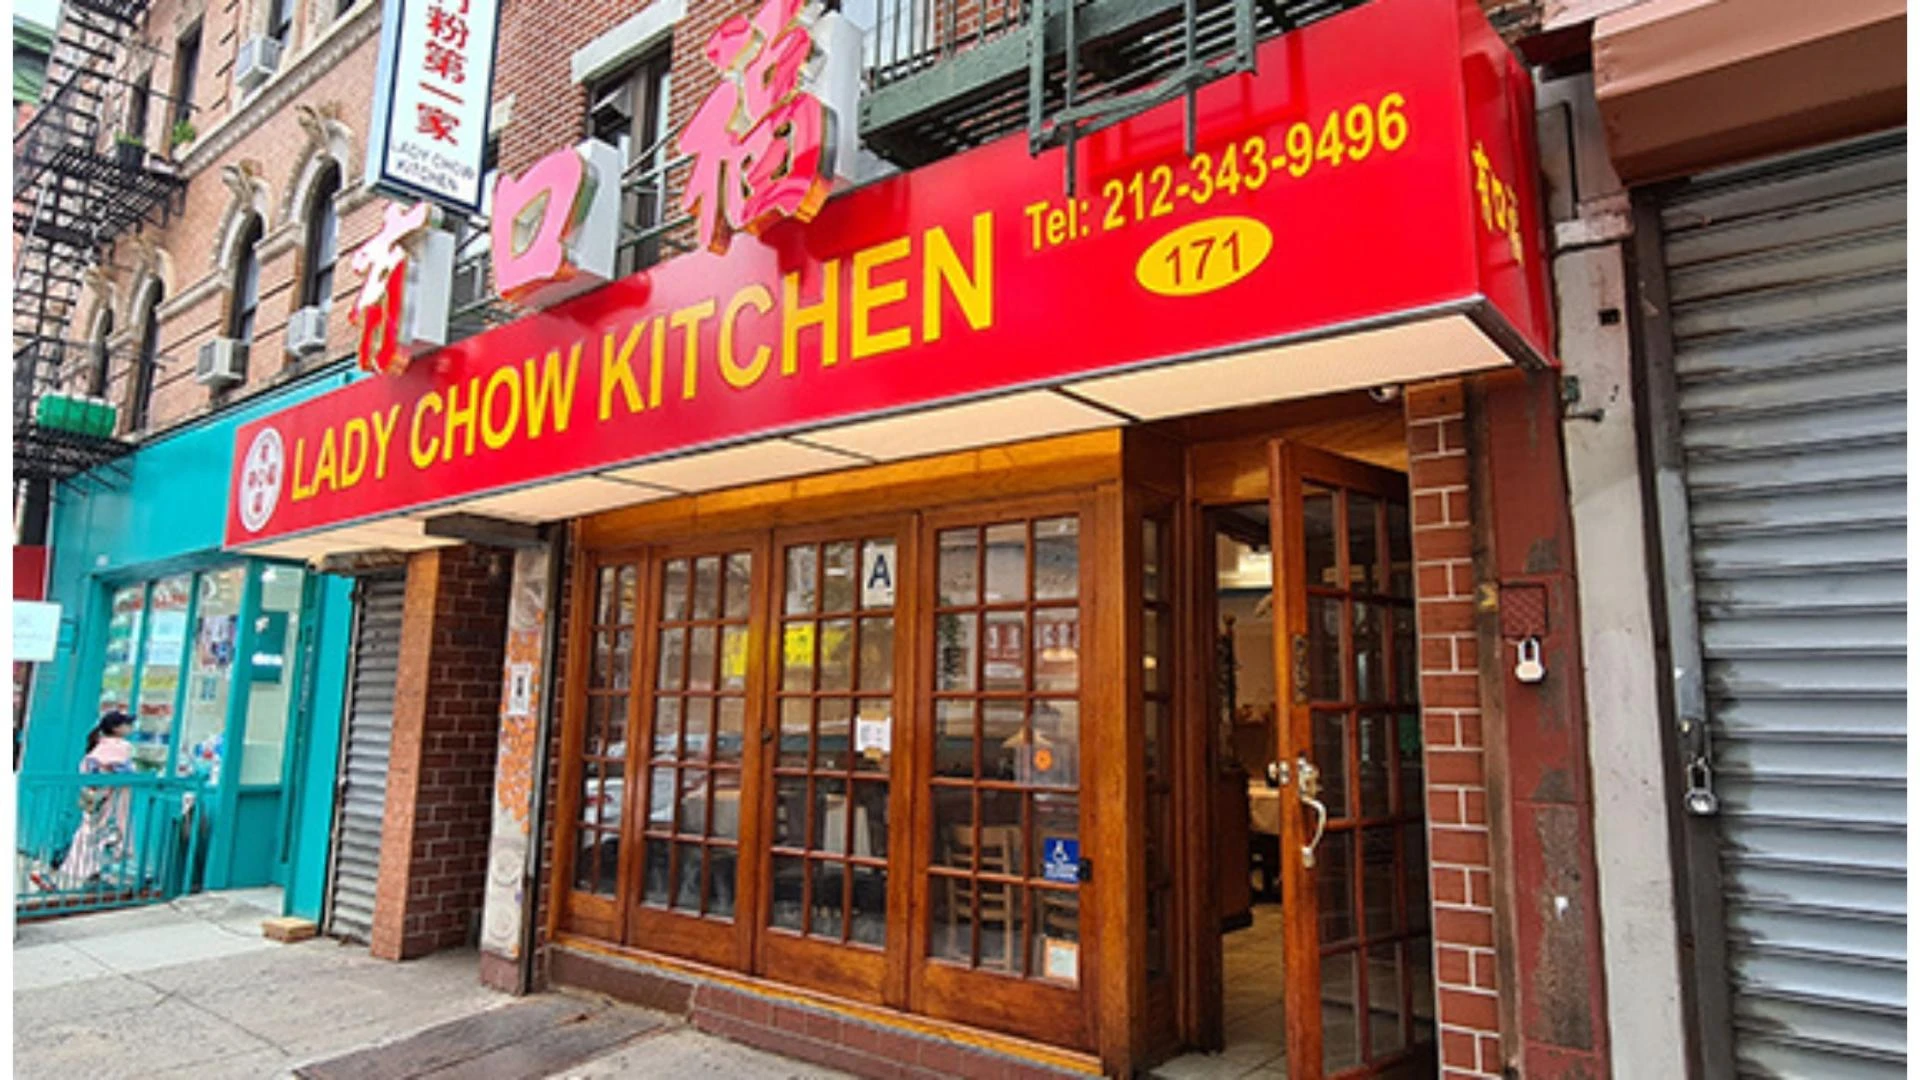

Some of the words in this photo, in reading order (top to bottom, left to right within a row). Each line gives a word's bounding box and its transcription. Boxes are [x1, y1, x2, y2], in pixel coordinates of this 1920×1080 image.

[416, 0, 469, 146] 粉第一家
[391, 141, 430, 161] LADY
[431, 152, 475, 180] CHOW
[397, 159, 458, 191] KITCHEN
[1025, 197, 1089, 250] Tel:
[1103, 92, 1408, 231] 212-343-9496
[1165, 231, 1240, 286] 171
[292, 404, 400, 501] LADY
[410, 341, 582, 469] CHOW
[599, 211, 993, 421] KITCHEN
[867, 554, 891, 589] A
